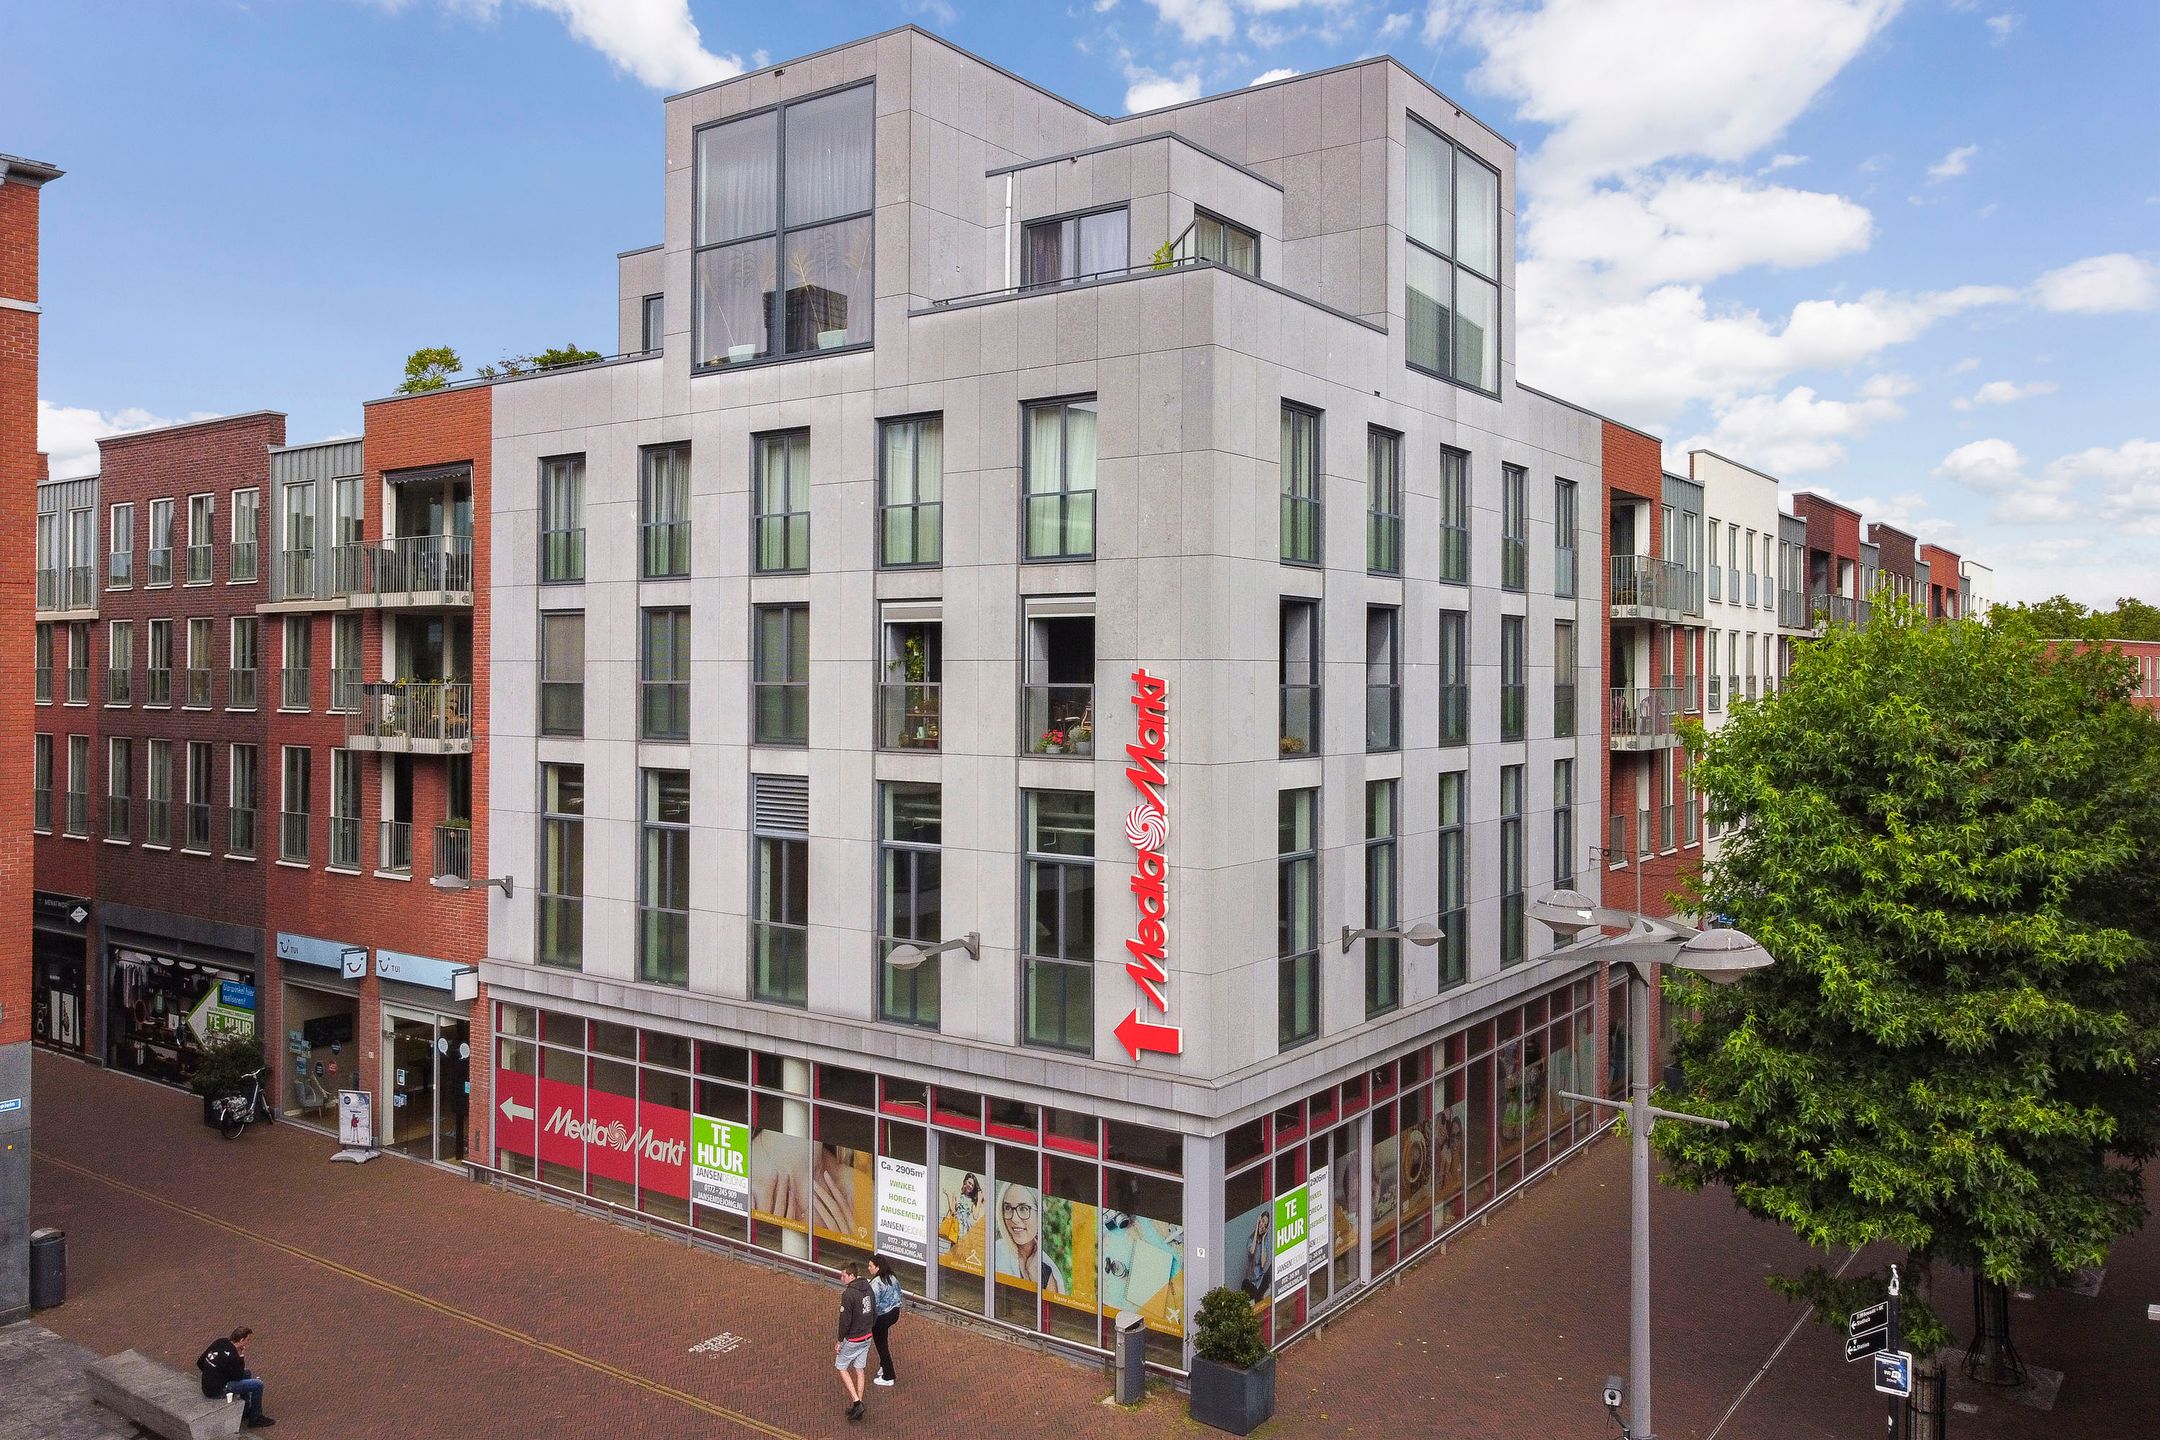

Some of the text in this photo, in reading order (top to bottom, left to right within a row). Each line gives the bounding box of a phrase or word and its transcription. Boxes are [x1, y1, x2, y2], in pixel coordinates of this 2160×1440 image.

[208, 1013, 220, 1029] TE
[710, 1122, 731, 1148] TE
[697, 1141, 744, 1174] HUUR
[880, 1160, 893, 1171] Ca.
[889, 1179, 916, 1192] WINKEL
[888, 1193, 917, 1206] HORECA
[880, 1204, 925, 1221] AMUSEMENT
[1284, 1197, 1298, 1220] TE
[1276, 1217, 1305, 1250] HUUR
